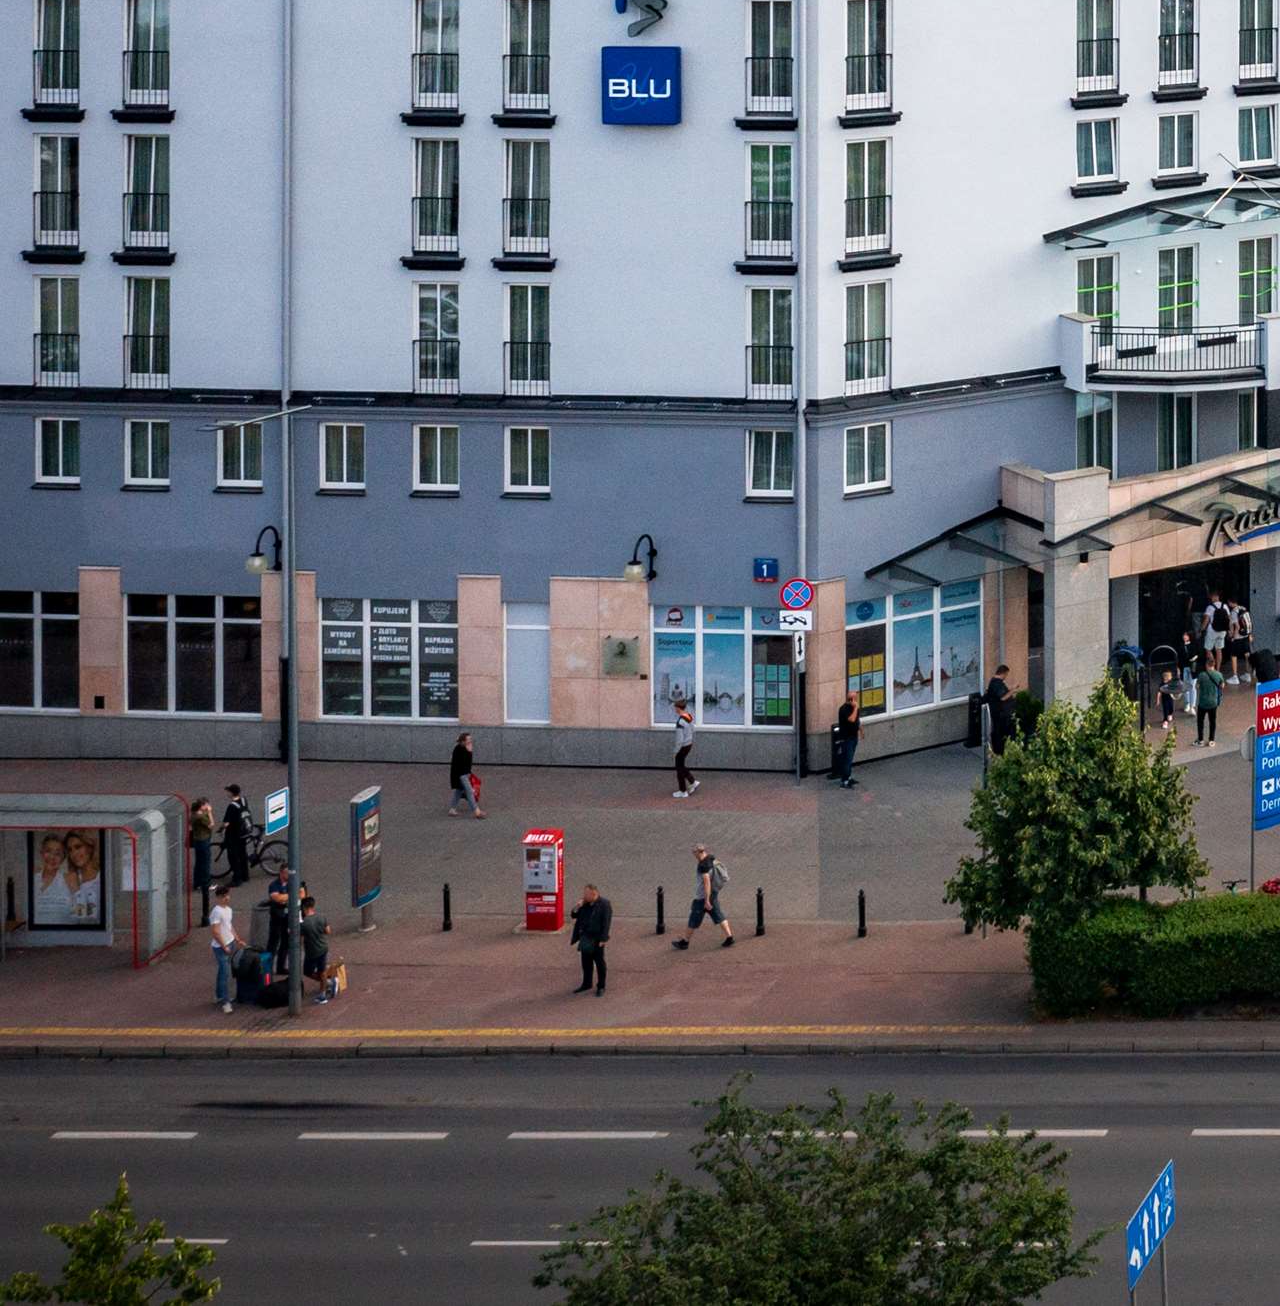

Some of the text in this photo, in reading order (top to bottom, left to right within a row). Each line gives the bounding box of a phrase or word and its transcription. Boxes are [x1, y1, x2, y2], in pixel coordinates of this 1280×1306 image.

[608, 78, 671, 98] BLU
[761, 564, 768, 577] 1
[374, 607, 409, 615] KUPUJEMY
[524, 834, 555, 842] BILETY
